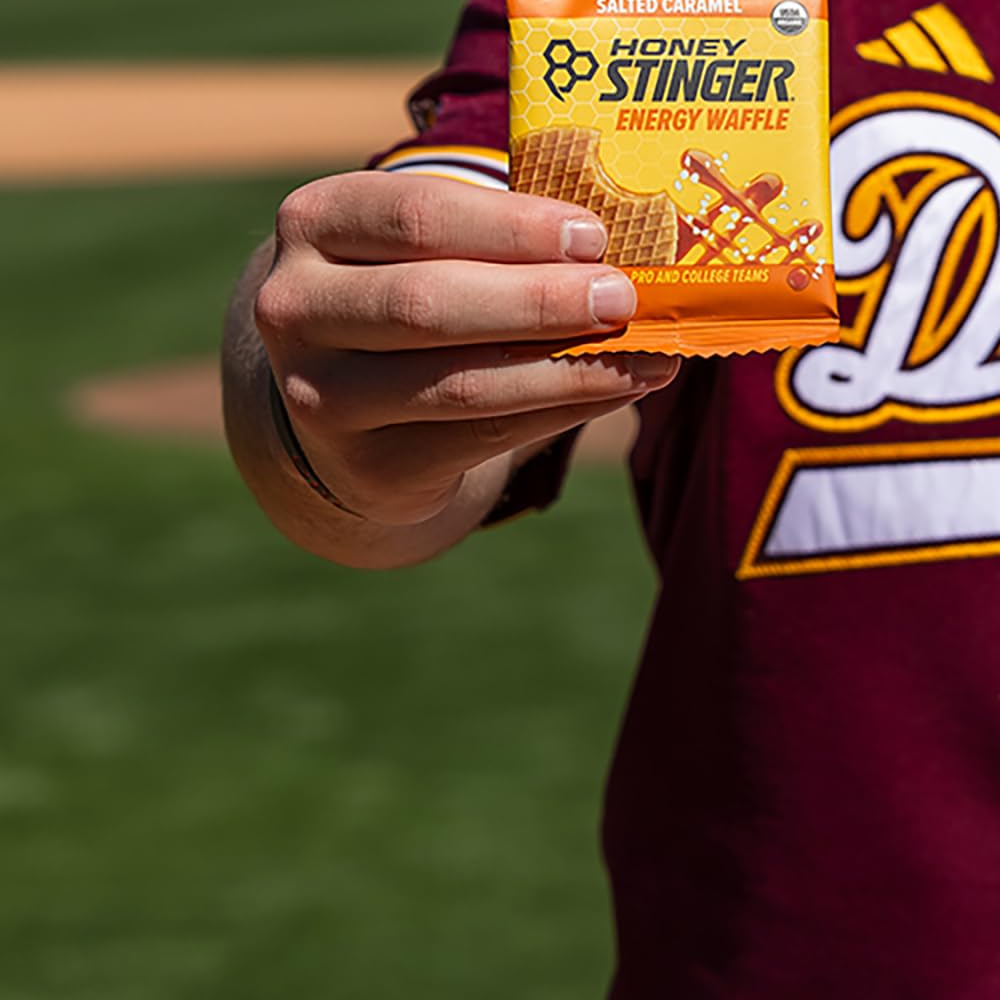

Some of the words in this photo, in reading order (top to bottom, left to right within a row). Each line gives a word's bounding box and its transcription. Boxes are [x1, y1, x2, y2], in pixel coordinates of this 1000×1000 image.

[610, 38, 747, 56] HONEY
[599, 59, 795, 102] STINGER
[616, 108, 703, 131] ENERGY
[706, 108, 790, 131] WAFFLE
[630, 270, 655, 284] PRO
[655, 270, 680, 284] AND
[681, 269, 730, 283] COLLEGE
[732, 268, 769, 282] TEAMS
